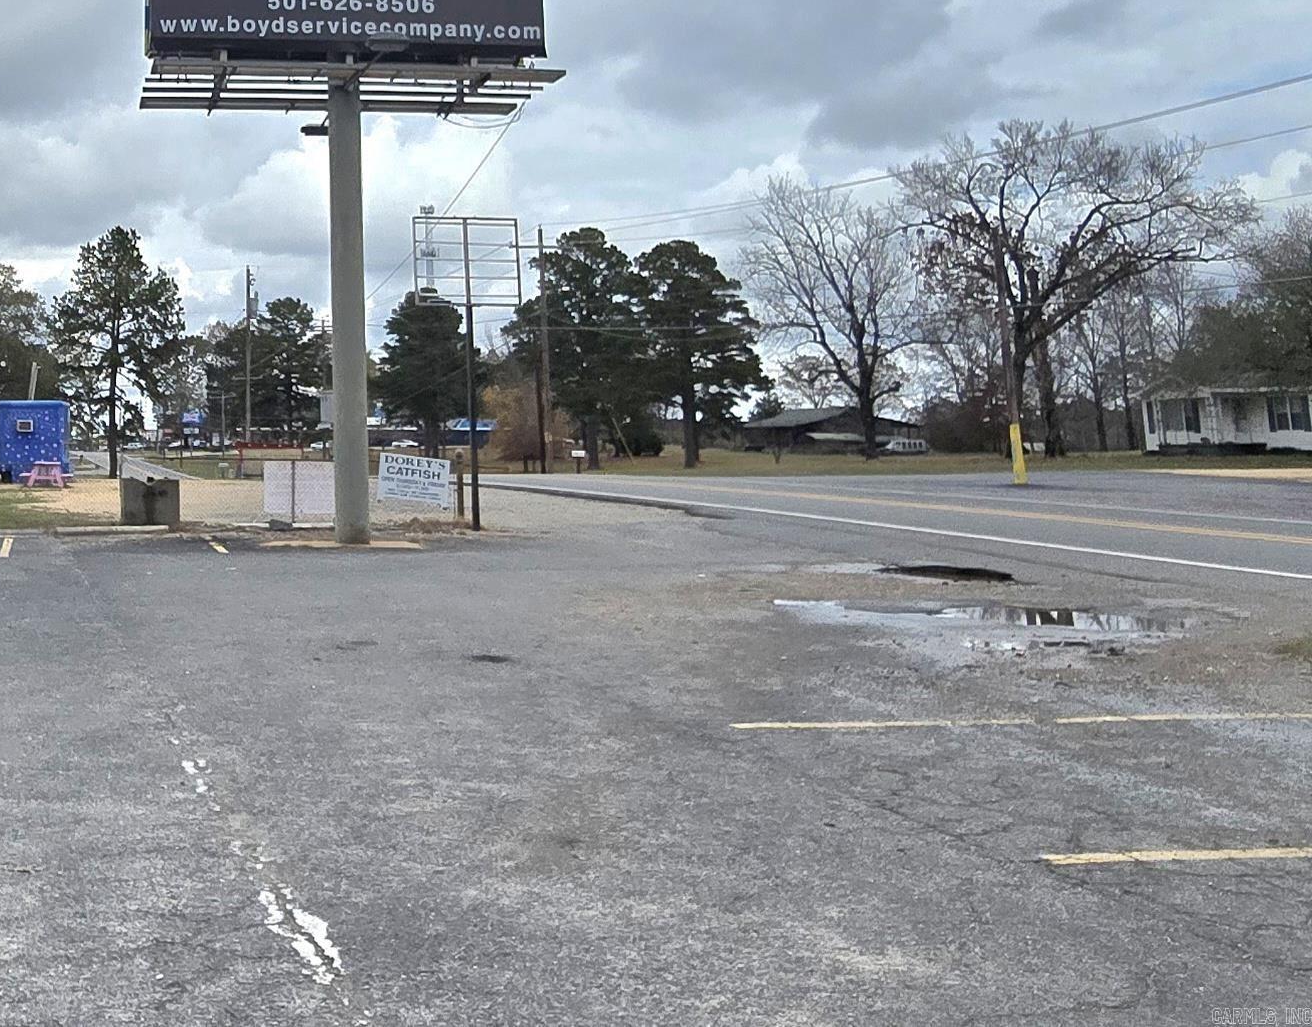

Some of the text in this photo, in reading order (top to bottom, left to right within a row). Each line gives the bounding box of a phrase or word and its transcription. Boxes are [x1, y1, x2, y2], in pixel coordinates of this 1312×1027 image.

[160, 15, 540, 42] www.boydservicecompany.com
[385, 455, 446, 470] DOREY'S
[387, 466, 440, 480] CATFISH
